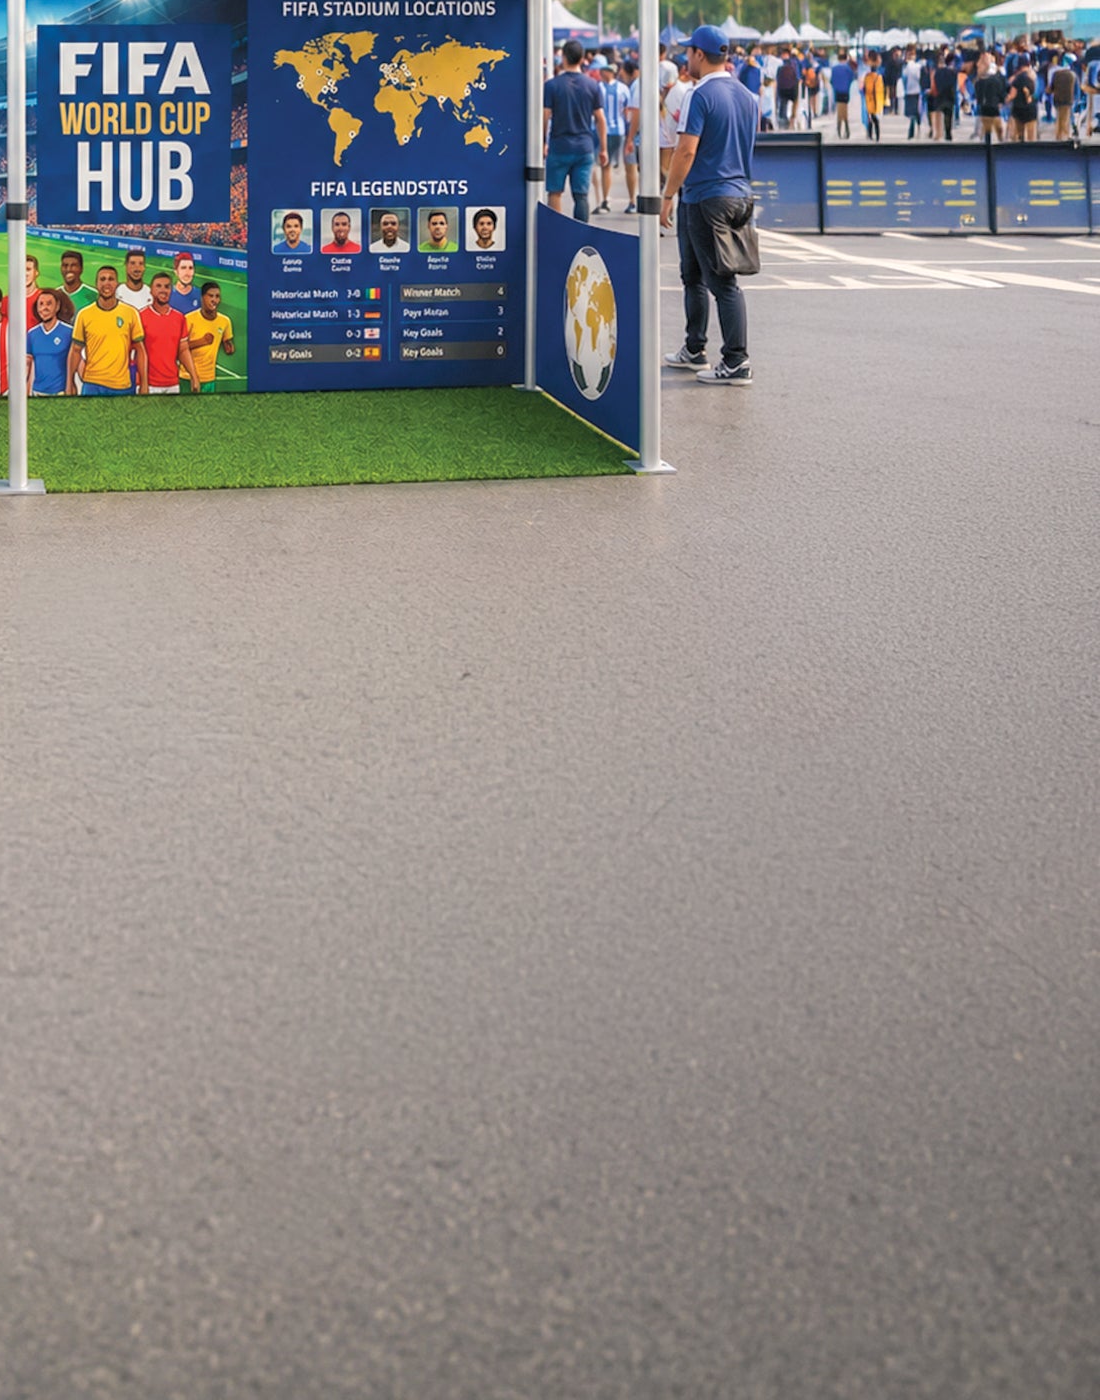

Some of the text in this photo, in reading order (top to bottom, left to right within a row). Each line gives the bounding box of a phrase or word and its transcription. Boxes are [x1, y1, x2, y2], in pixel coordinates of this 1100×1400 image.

[282, 0, 496, 17] FIFA STADIUM LOCATIONS
[59, 41, 211, 95] FIFA
[59, 101, 211, 135] WORLD CUP
[77, 140, 194, 212] HUB
[311, 179, 469, 197] FIFA LEGENDSTATS
[271, 290, 311, 299] Historical
[313, 289, 338, 298] Match
[434, 287, 461, 297] Match
[271, 310, 311, 319] Historical
[313, 310, 338, 318] Match
[498, 305, 504, 316] 3
[271, 331, 287, 341] Key
[288, 330, 312, 339] Goals
[403, 326, 504, 339] Key Goals 2
[271, 350, 287, 360] Key
[288, 349, 313, 359] Goals
[402, 345, 504, 358] Key Goals 0
